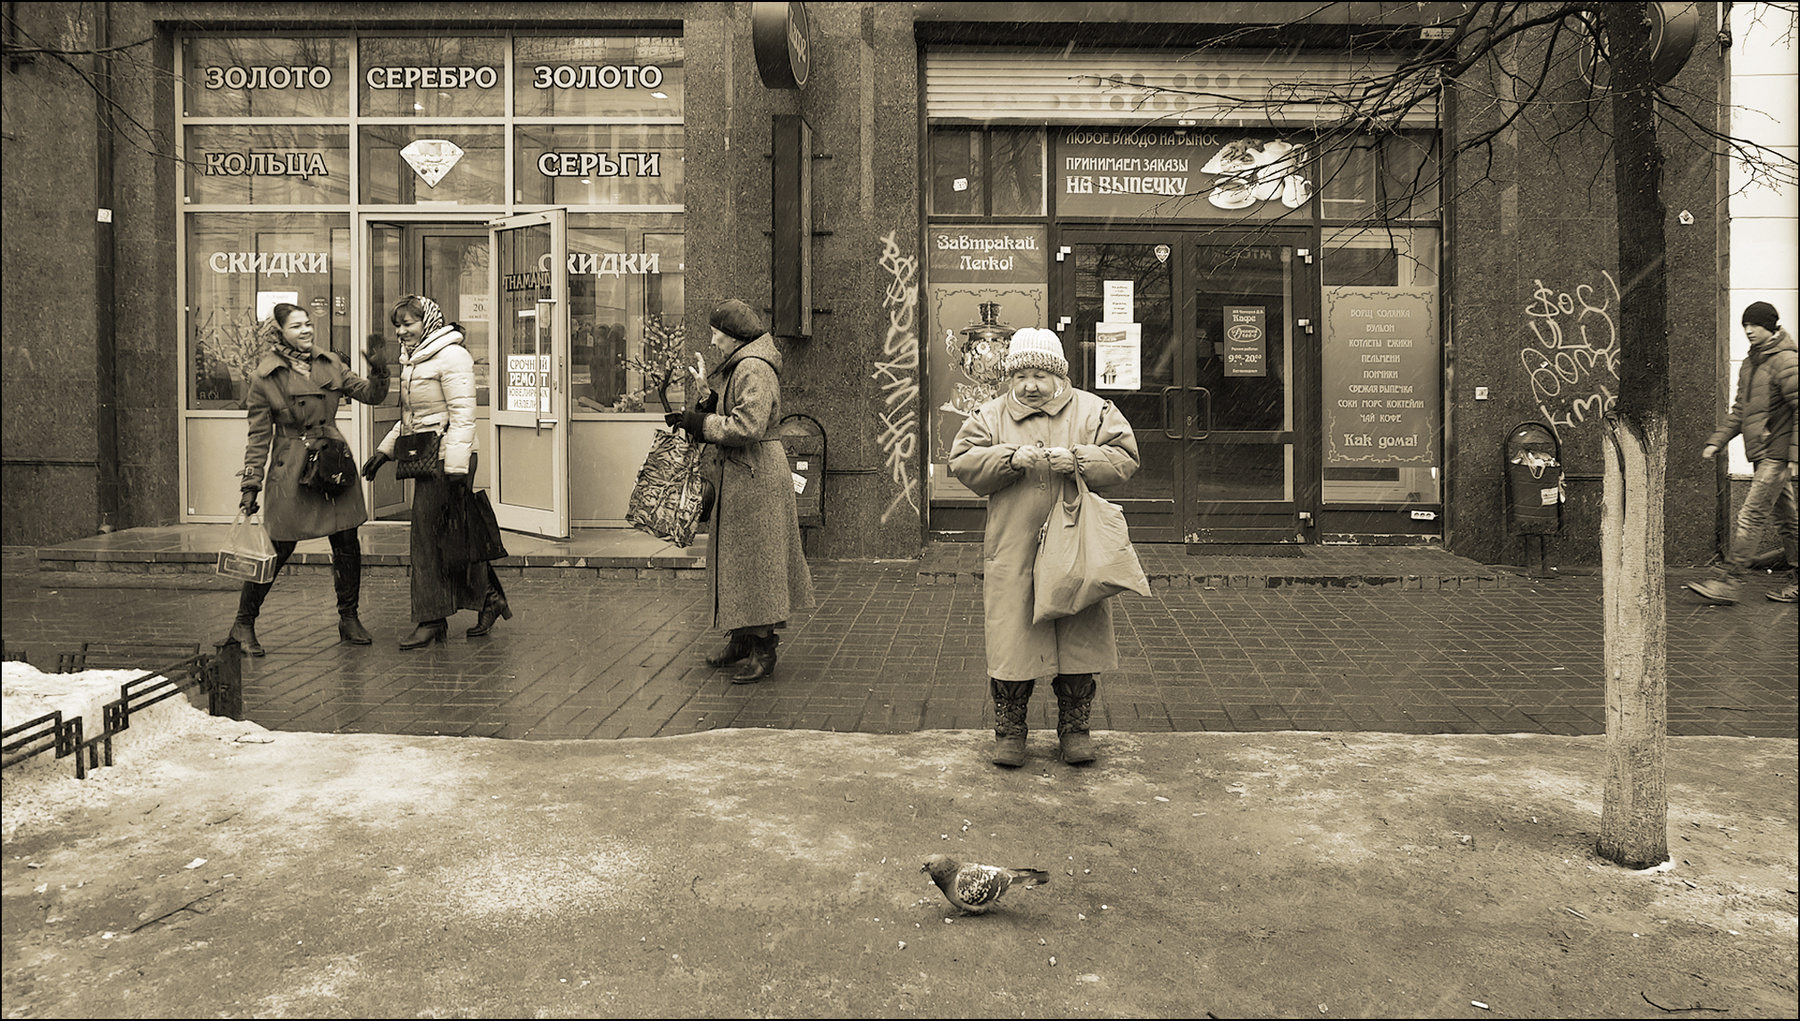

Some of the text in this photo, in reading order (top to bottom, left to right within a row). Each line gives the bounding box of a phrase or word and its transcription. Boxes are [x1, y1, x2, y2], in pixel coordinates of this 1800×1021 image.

[205, 65, 331, 90] ЗОЛОТО
[366, 66, 498, 90] СЕРЕБРО
[533, 65, 664, 90] ЗОЛОТО
[1065, 132, 1220, 148] ЛЮБОЕ БЛЮДО НА ВЫНОС
[205, 152, 329, 180] КОЛЬЦА
[537, 151, 661, 178] СЕРЬГИ
[1065, 157, 1189, 172] ПРИНИМАЕМ ЗАКАЗЫ
[1065, 176, 1189, 196] НА ВЫПЕЧКУ
[209, 251, 329, 278] СКИДКИ
[959, 255, 1014, 271] Легко!
[1232, 315, 1257, 324] Кафе
[1350, 309, 1411, 319] БОРЩ СОЛЯНКА
[1366, 324, 1395, 333] БУЛЬОН
[1348, 339, 1382, 348] КОТЛЕТЫ
[510, 357, 548, 370] СРОЧНЙ
[1361, 354, 1401, 364] ПЕЛЬМЕНИ
[510, 372, 548, 387] РЕМОТ
[1363, 370, 1399, 379] ПОНЧИКИ
[1348, 385, 1414, 394] СВЕЖАЯ ВЫПЕЧКА
[1337, 398, 1425, 409] СОКИ МОРС КОКТЕЙЛИ
[1360, 413, 1402, 423] ЧАЙ КОФЕ
[1343, 433, 1419, 450] Как дома!
